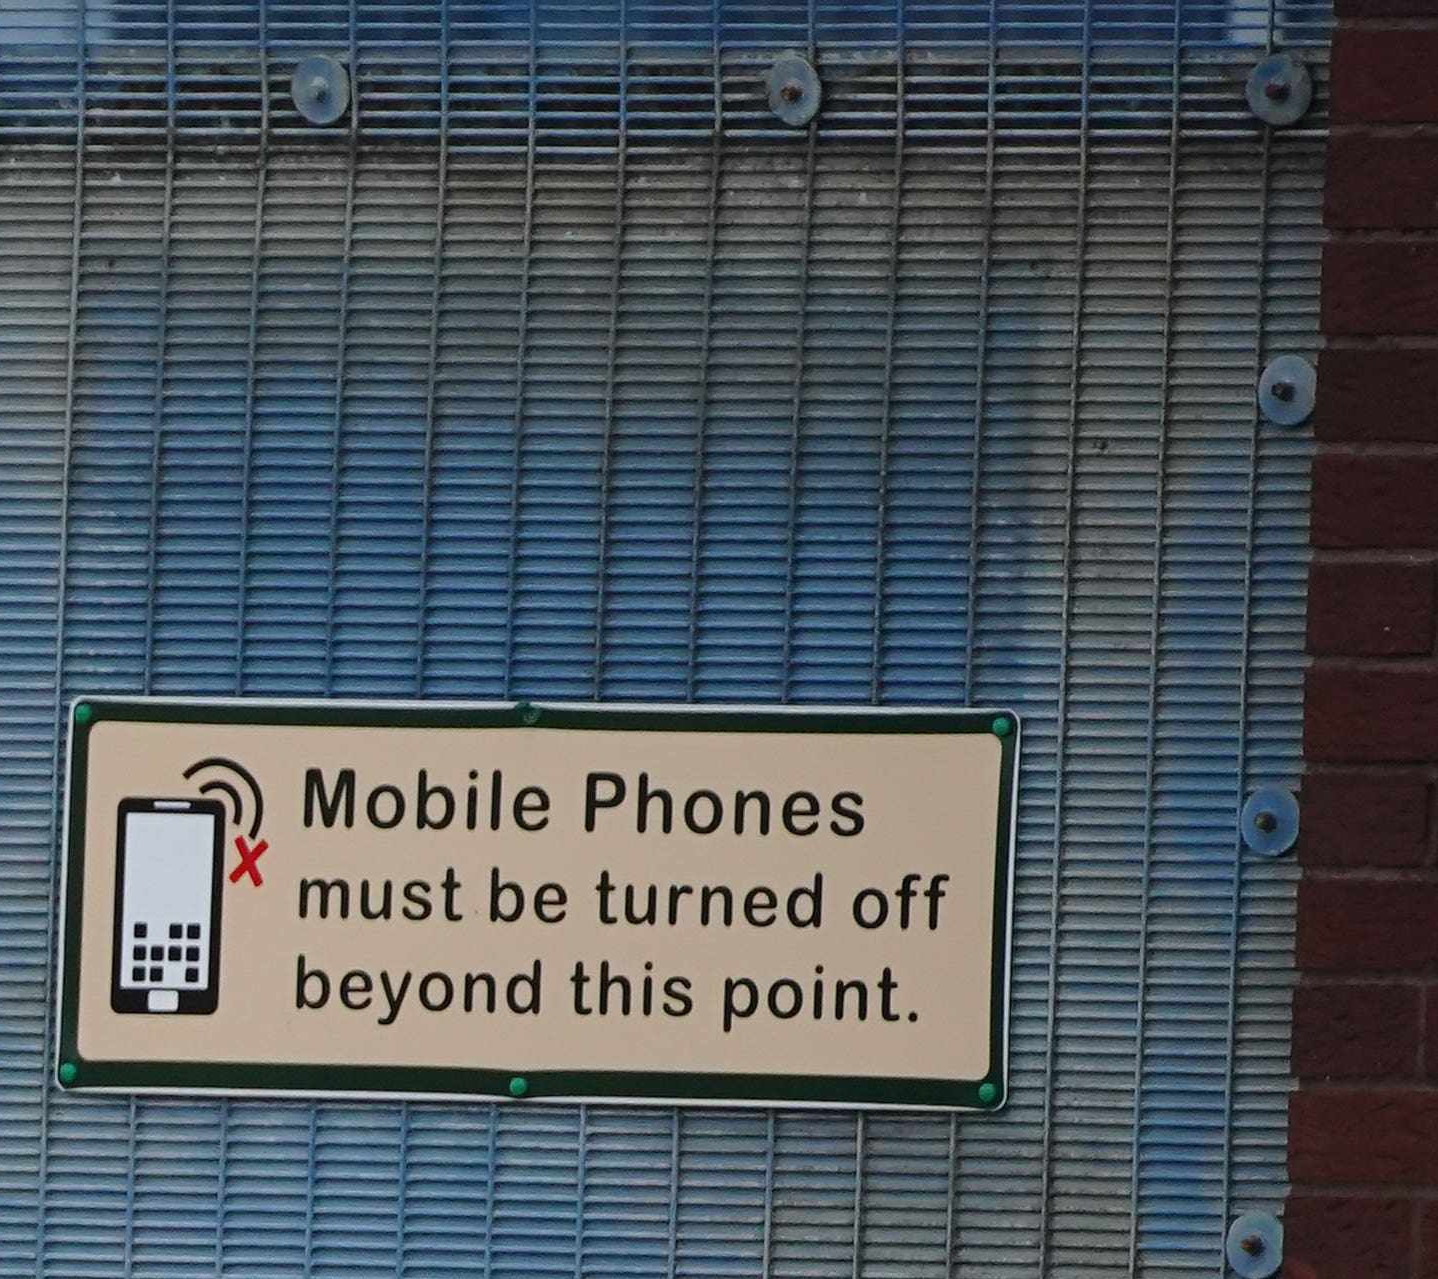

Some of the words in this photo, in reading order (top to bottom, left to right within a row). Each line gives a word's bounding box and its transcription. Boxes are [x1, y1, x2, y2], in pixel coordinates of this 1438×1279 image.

[302, 767, 552, 833] Mobile
[583, 770, 866, 839] Phones
[297, 865, 465, 923] must
[488, 865, 569, 925] be
[593, 869, 825, 930] turned
[851, 872, 952, 932] off
[294, 952, 543, 1027] beyond
[568, 958, 694, 1019] this
[720, 963, 920, 1035] point.
